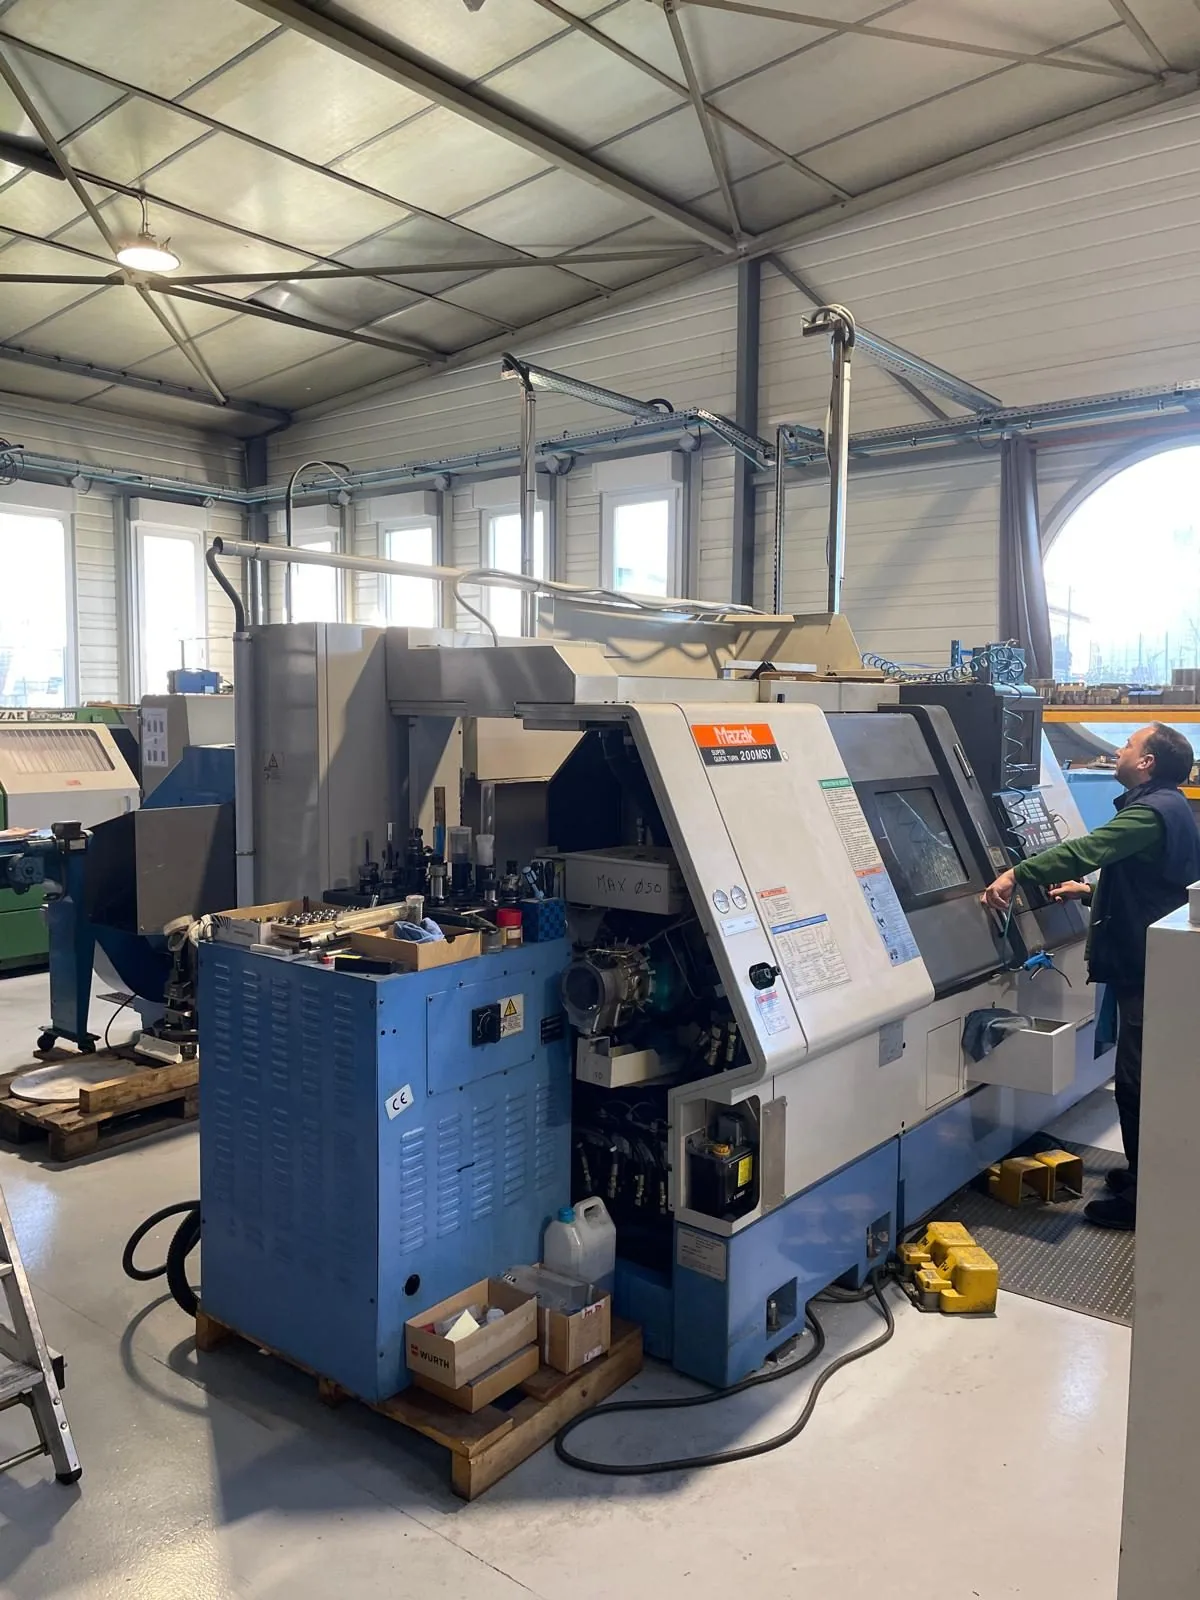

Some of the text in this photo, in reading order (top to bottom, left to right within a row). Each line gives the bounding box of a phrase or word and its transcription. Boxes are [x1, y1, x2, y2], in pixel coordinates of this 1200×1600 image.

[713, 725, 757, 745] Mazak
[739, 748, 772, 761] 200MSY
[596, 874, 627, 895] MAX
[392, 1091, 408, 1111] CE
